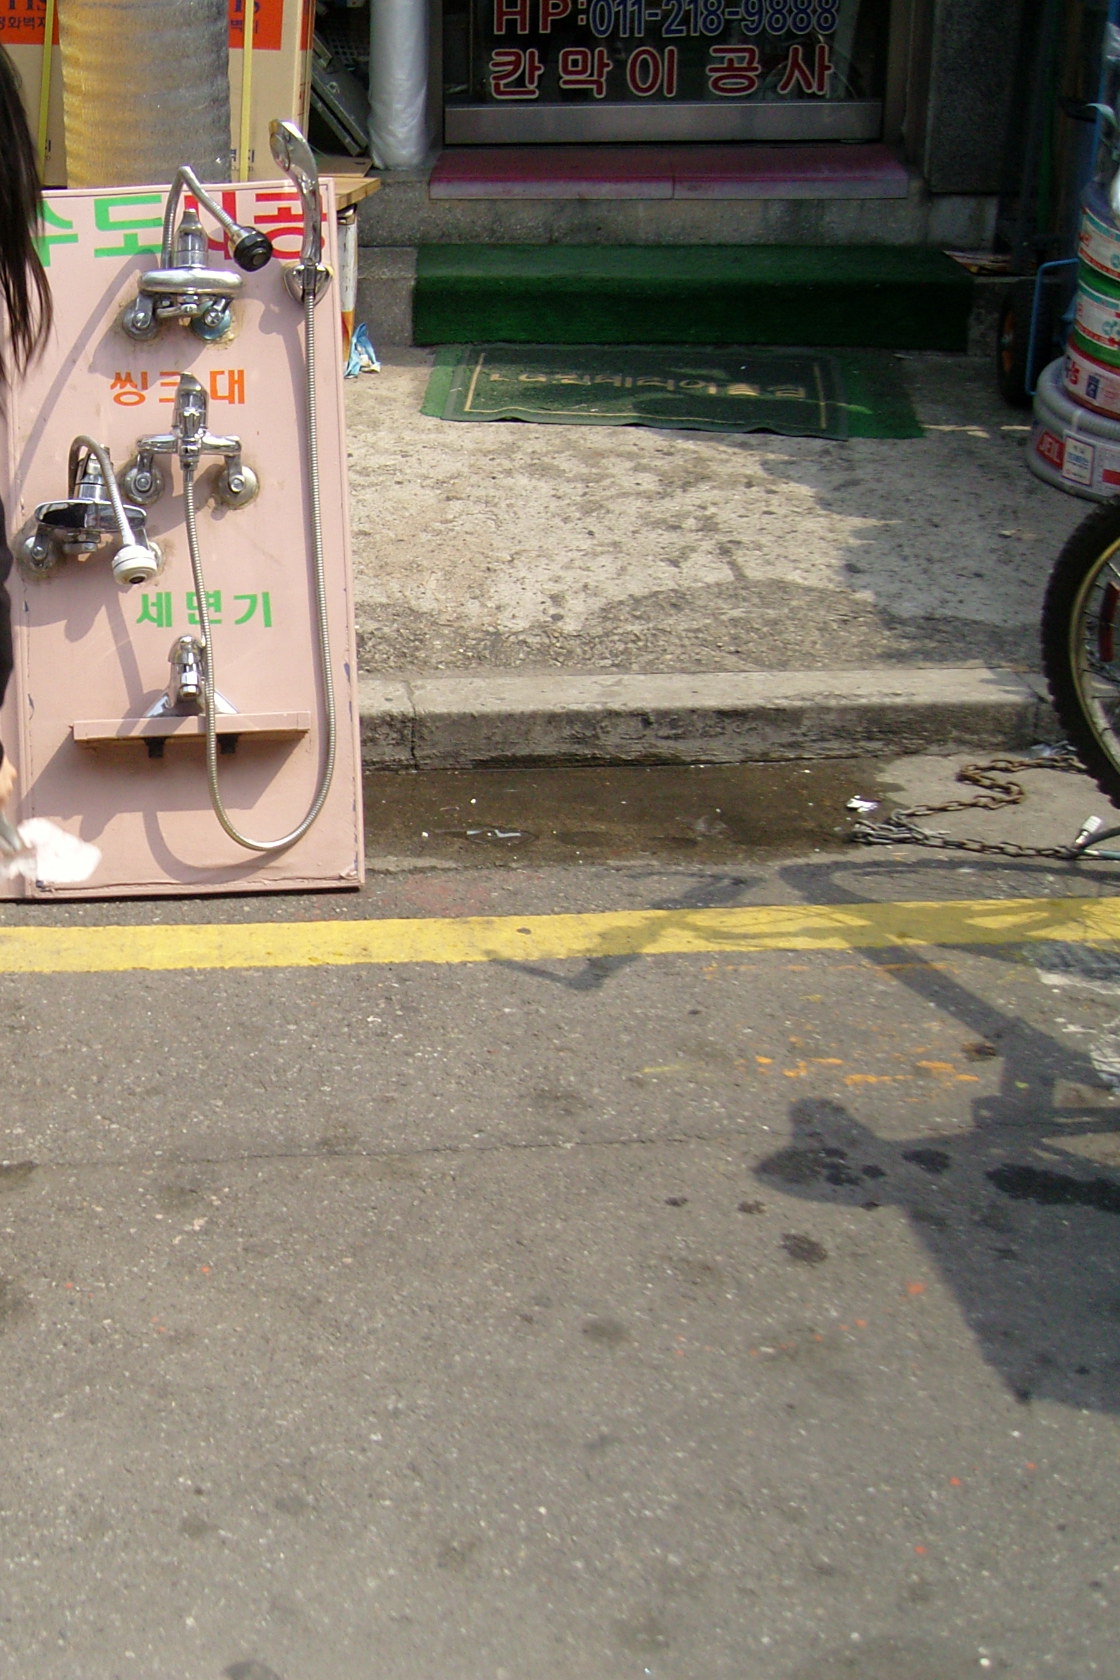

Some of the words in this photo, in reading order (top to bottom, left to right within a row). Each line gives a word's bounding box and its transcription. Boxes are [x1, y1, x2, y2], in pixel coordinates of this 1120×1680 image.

[490, 47, 678, 98] 칸막이
[706, 44, 833, 97] 공사
[110, 368, 246, 407] 씽크대
[136, 589, 273, 628] 세면기
